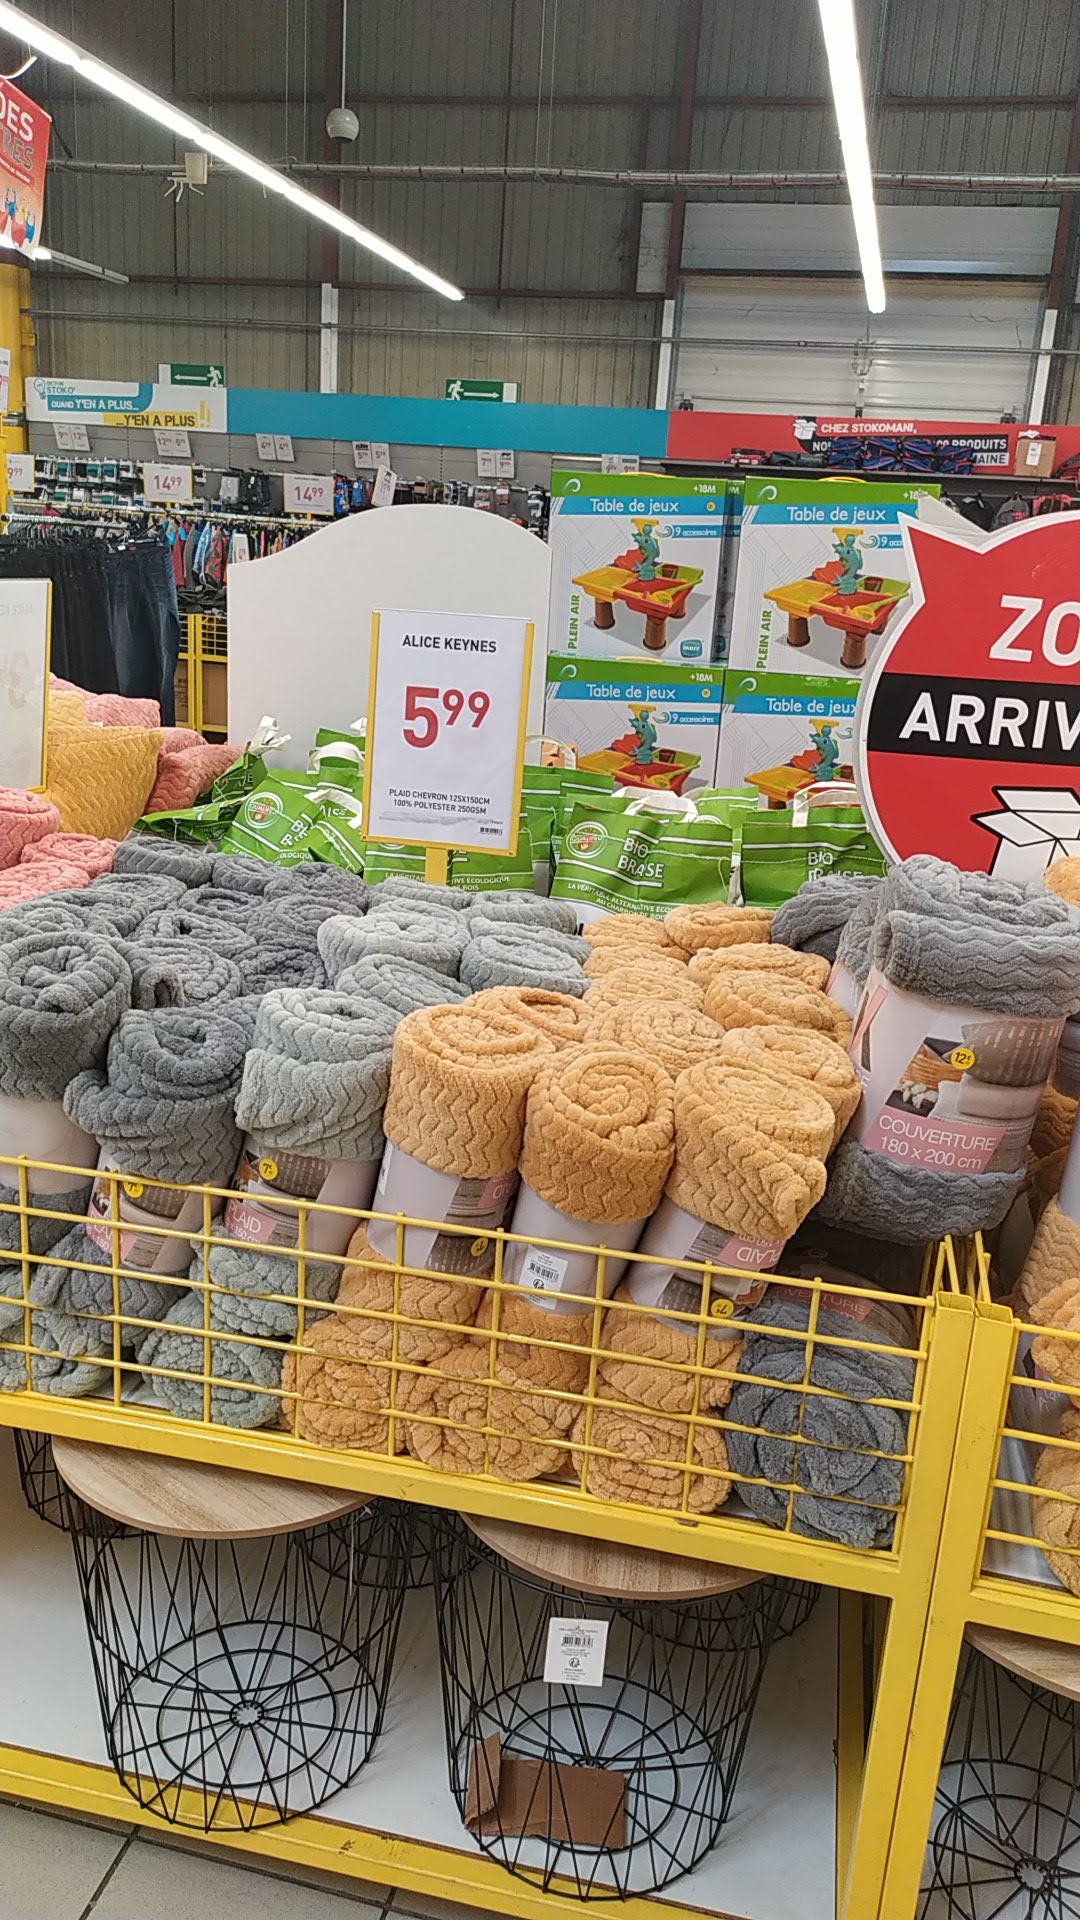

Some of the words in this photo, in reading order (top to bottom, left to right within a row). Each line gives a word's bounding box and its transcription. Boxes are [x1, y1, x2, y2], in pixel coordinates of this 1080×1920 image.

[51, 401, 74, 409] QUAND
[99, 401, 106, 410] A
[152, 415, 161, 426] A
[164, 415, 196, 427] PLUS
[820, 423, 849, 433] CHEZ
[951, 439, 1007, 450] PRODUITS
[153, 475, 182, 491] 1499
[294, 486, 324, 502] 1499
[589, 498, 624, 512] Table
[628, 499, 645, 512] de
[649, 498, 679, 515] jeux
[787, 506, 825, 521] Table
[829, 507, 848, 521] de
[852, 506, 886, 524] jeux
[675, 526, 681, 537] 9
[682, 529, 717, 537] accessoires
[881, 536, 888, 547] 9
[570, 594, 580, 615] AIR
[760, 610, 772, 631] AIR
[567, 618, 579, 650] PLEIN
[402, 634, 441, 649] ALICE
[444, 637, 497, 653] KEYNES
[756, 634, 769, 669] PLEIN
[586, 684, 621, 698] Table
[625, 684, 642, 698] de
[646, 684, 676, 701] jeux
[765, 697, 802, 712] Table
[807, 699, 825, 713] de
[403, 685, 490, 748] 599
[672, 713, 678, 723] 9
[389, 788, 411, 798] PLAID
[412, 791, 448, 801] CHEVRON
[449, 794, 490, 805] 125X150CM
[393, 799, 412, 808] 100%
[413, 800, 456, 812] POLYESTER
[457, 804, 487, 815] 250GSM
[623, 837, 649, 859] BIO
[807, 850, 834, 866] BIO
[466, 876, 510, 885] ÉCOLOGIQUE
[576, 882, 610, 901] VÉRITABLE
[610, 897, 655, 912] ALTERNATIVE
[879, 1115, 997, 1151] COUVERTURE
[880, 1136, 909, 1156] 180
[911, 1147, 921, 1160] x
[924, 1149, 955, 1166] 200
[957, 1157, 982, 1169] cm
[229, 1202, 262, 1234] PLAID
[736, 1246, 780, 1264] PLAID
